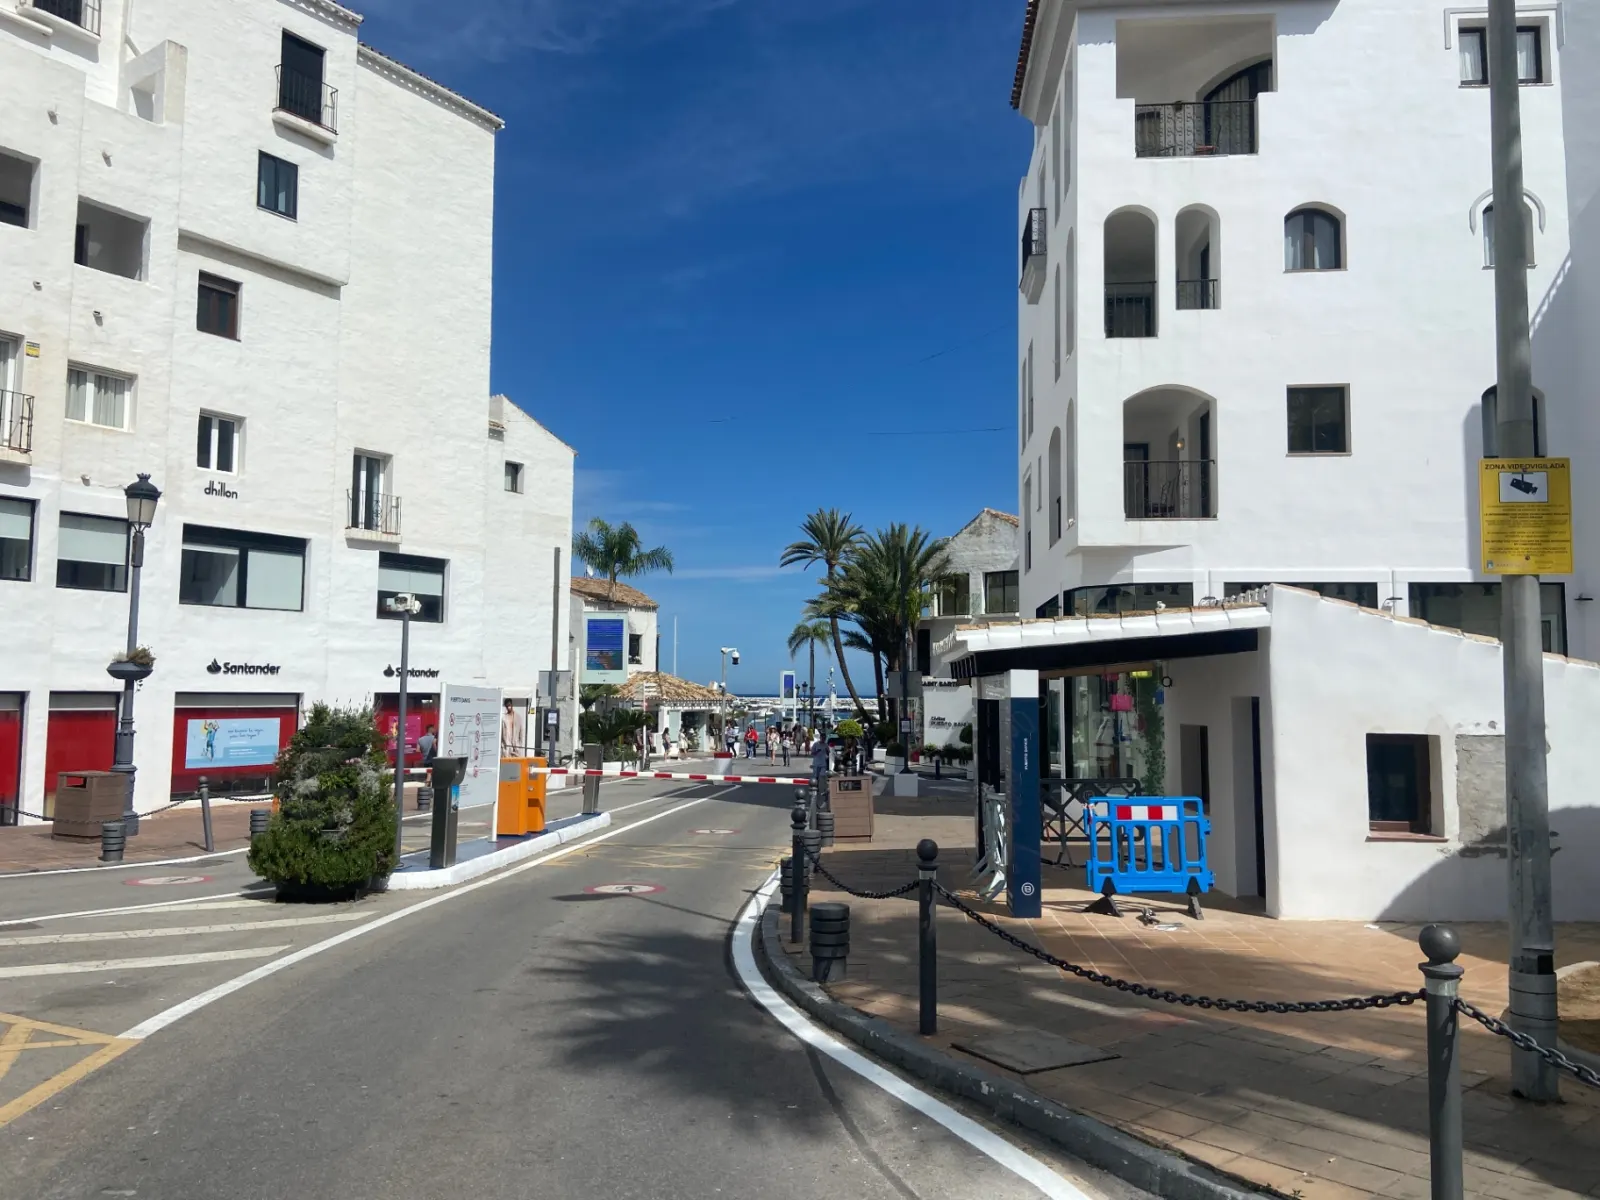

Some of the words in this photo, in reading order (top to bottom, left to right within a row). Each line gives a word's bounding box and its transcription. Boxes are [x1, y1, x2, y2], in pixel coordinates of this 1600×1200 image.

[1507, 462, 1566, 470] VIDEOVIGILADA
[204, 480, 238, 499] dhillon
[222, 662, 281, 675] Santander
[395, 667, 440, 678] Sntander
